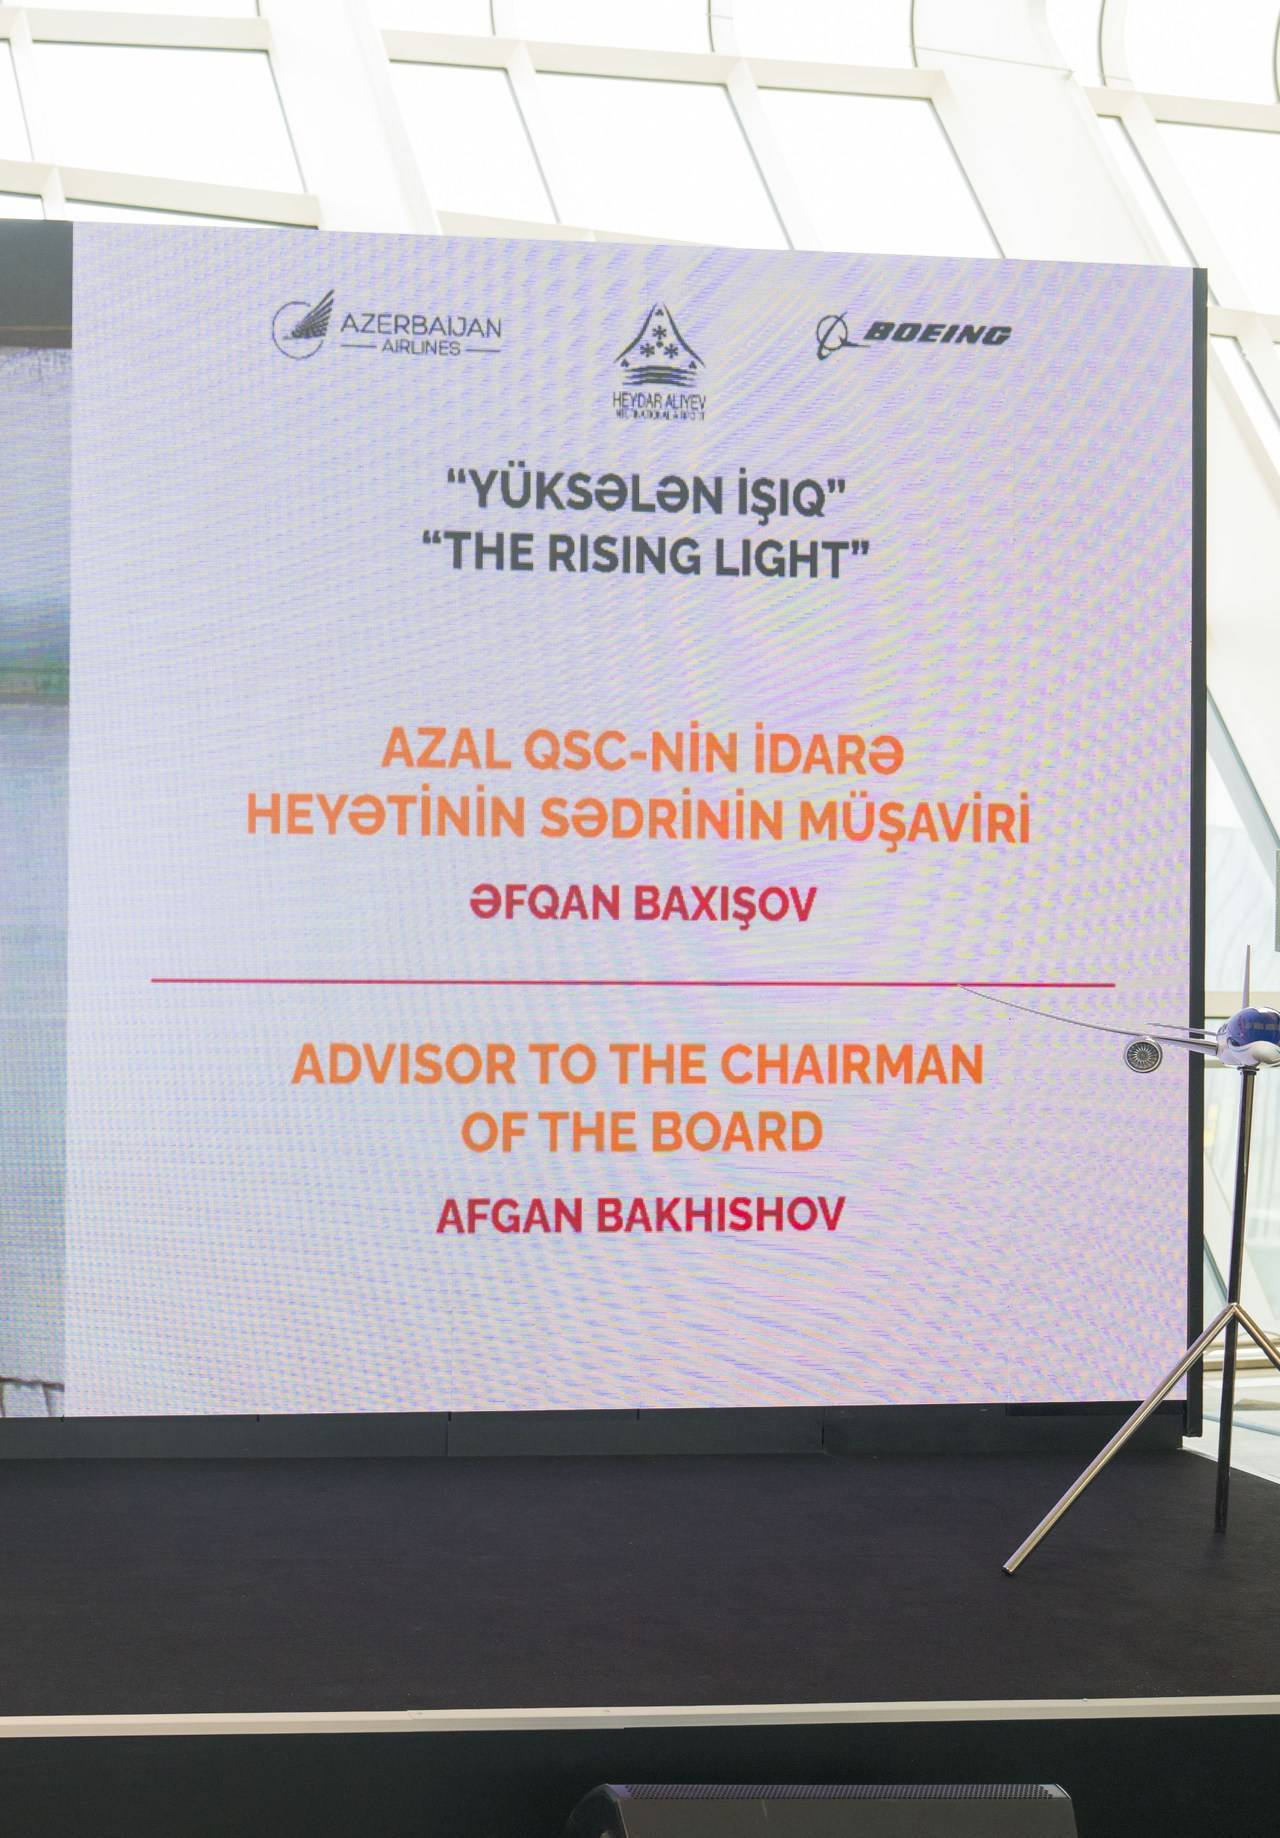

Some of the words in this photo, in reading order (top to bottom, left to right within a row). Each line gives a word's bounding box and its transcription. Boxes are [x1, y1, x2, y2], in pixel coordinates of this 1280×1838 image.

[340, 312, 502, 339] AZERBAIJAN
[863, 321, 1013, 346] BOEING
[381, 339, 461, 356] AIRLINES
[612, 391, 662, 409] HEYDAR
[665, 394, 706, 411] ALIYEV
[422, 529, 534, 572] “THE
[548, 533, 701, 576] RISING
[715, 540, 870, 580] LIGHT”
[381, 726, 512, 770] AZAL
[524, 719, 738, 774] QSC-NİN
[754, 721, 905, 775] İDARƏ
[247, 783, 525, 837] HEYƏTİNİN
[541, 788, 784, 841] SƏDRİNİN
[800, 791, 1030, 853] MÜŞAVİRİ
[469, 883, 621, 921] ƏFQAN
[634, 884, 818, 931] BAXIŞOV
[292, 1042, 516, 1085] ADVISOR
[528, 1042, 597, 1085] TO
[608, 1043, 707, 1085] THE
[720, 1043, 984, 1085] CHAIRMAN
[461, 1110, 529, 1153] OF
[537, 1110, 637, 1153] THE
[652, 1110, 824, 1154] BOARD
[436, 1197, 583, 1234] AFGAN
[597, 1196, 846, 1233] BAKHISHOV
